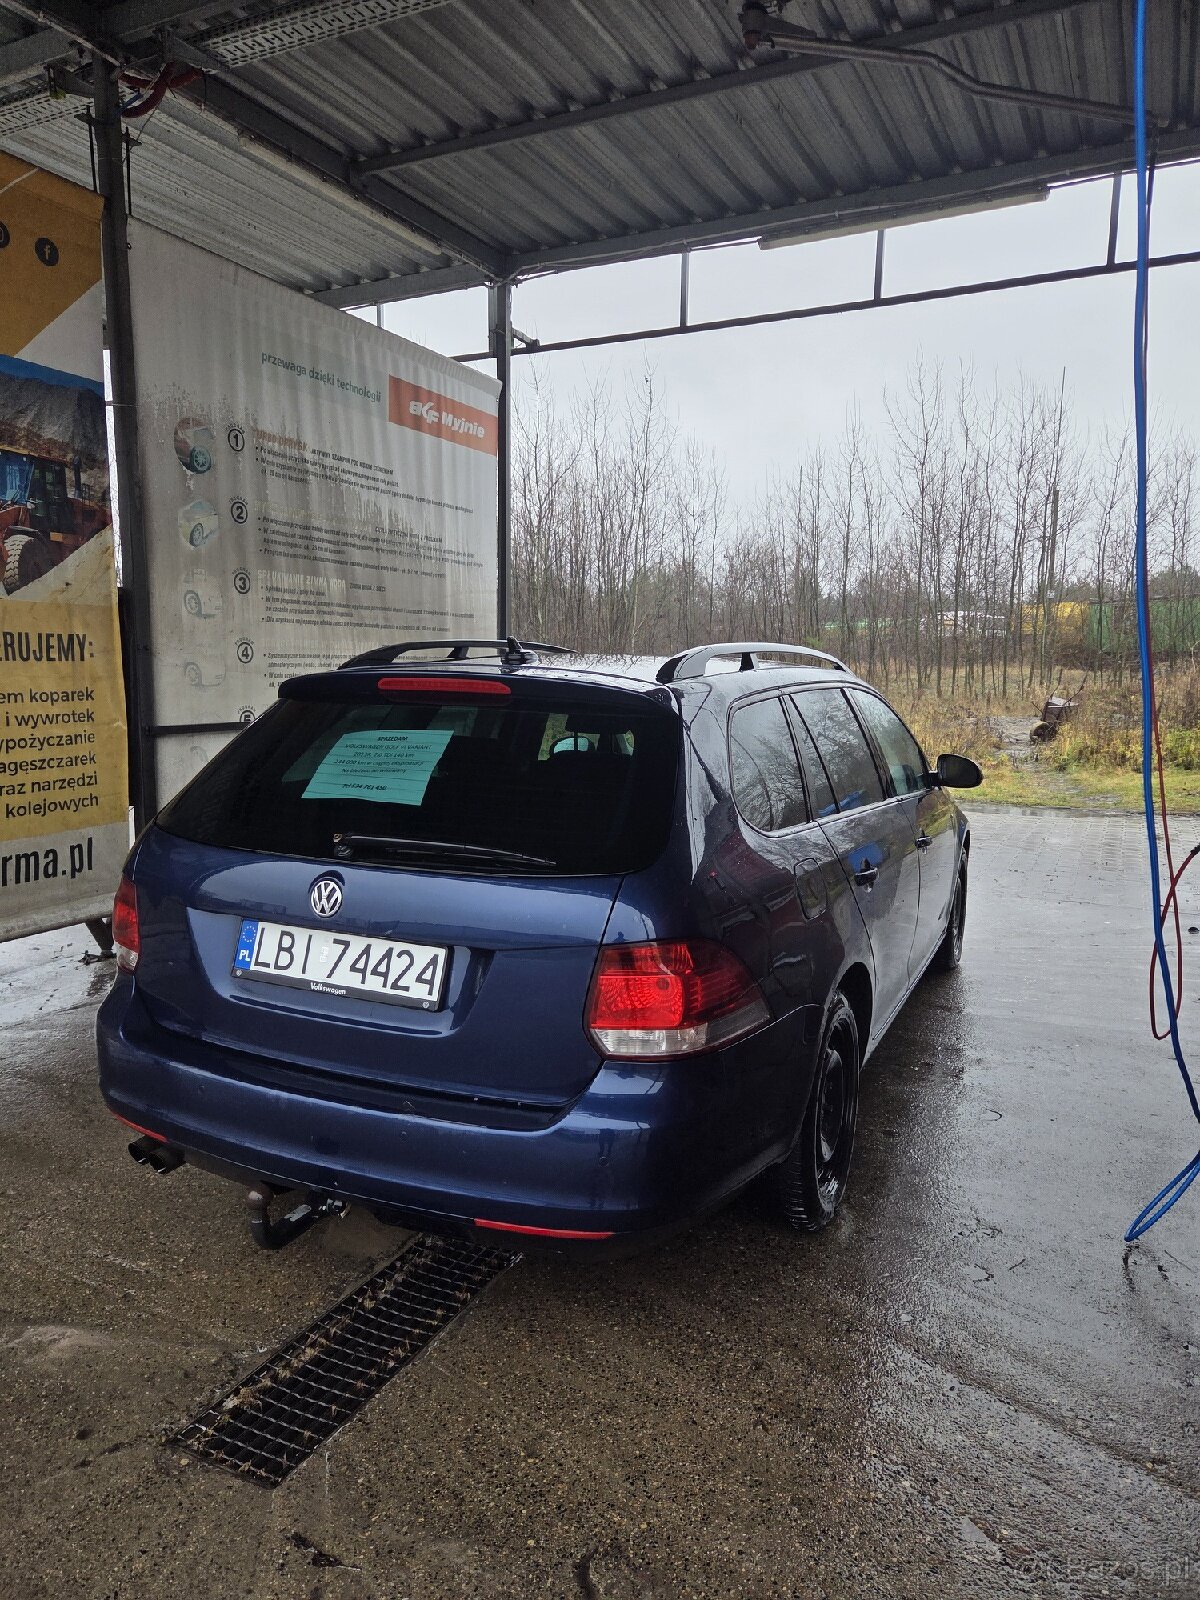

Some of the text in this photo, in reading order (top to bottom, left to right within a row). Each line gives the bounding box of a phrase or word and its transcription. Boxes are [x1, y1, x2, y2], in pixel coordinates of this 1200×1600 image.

[261, 352, 382, 403] przewaga dzięki technologii
[441, 411, 486, 439] Myjnie
[0, 631, 95, 662] RUJEMY:
[30, 687, 95, 706] koparek
[5, 708, 95, 729] i wywrotek
[31, 771, 98, 793] narzędzi
[6, 793, 99, 818] kolejowych
[2, 837, 93, 887] rma.pl
[238, 949, 250, 962] PL
[253, 927, 439, 996] LBI 74424
[310, 982, 347, 996] Volkswagen
